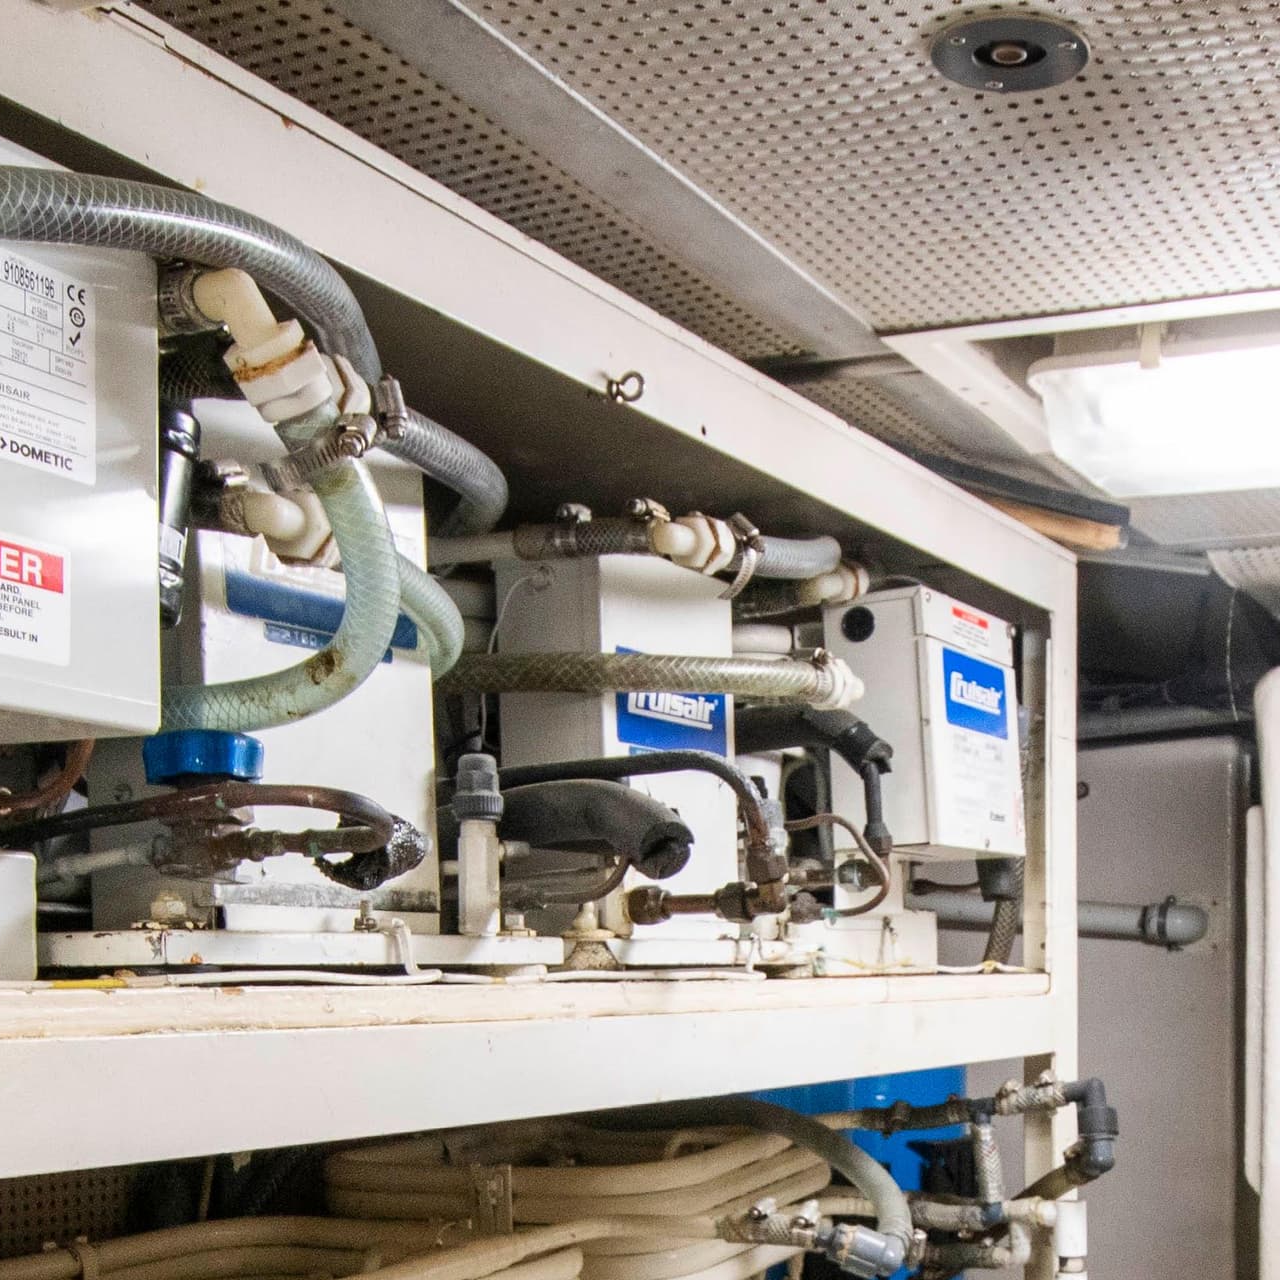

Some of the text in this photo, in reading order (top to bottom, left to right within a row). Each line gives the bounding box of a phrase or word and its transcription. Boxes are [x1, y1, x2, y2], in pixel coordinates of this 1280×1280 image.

[4, 260, 55, 299] 9108561196
[10, 440, 73, 471] DOMETIC
[12, 595, 41, 610] PANEL
[29, 633, 38, 643] IN
